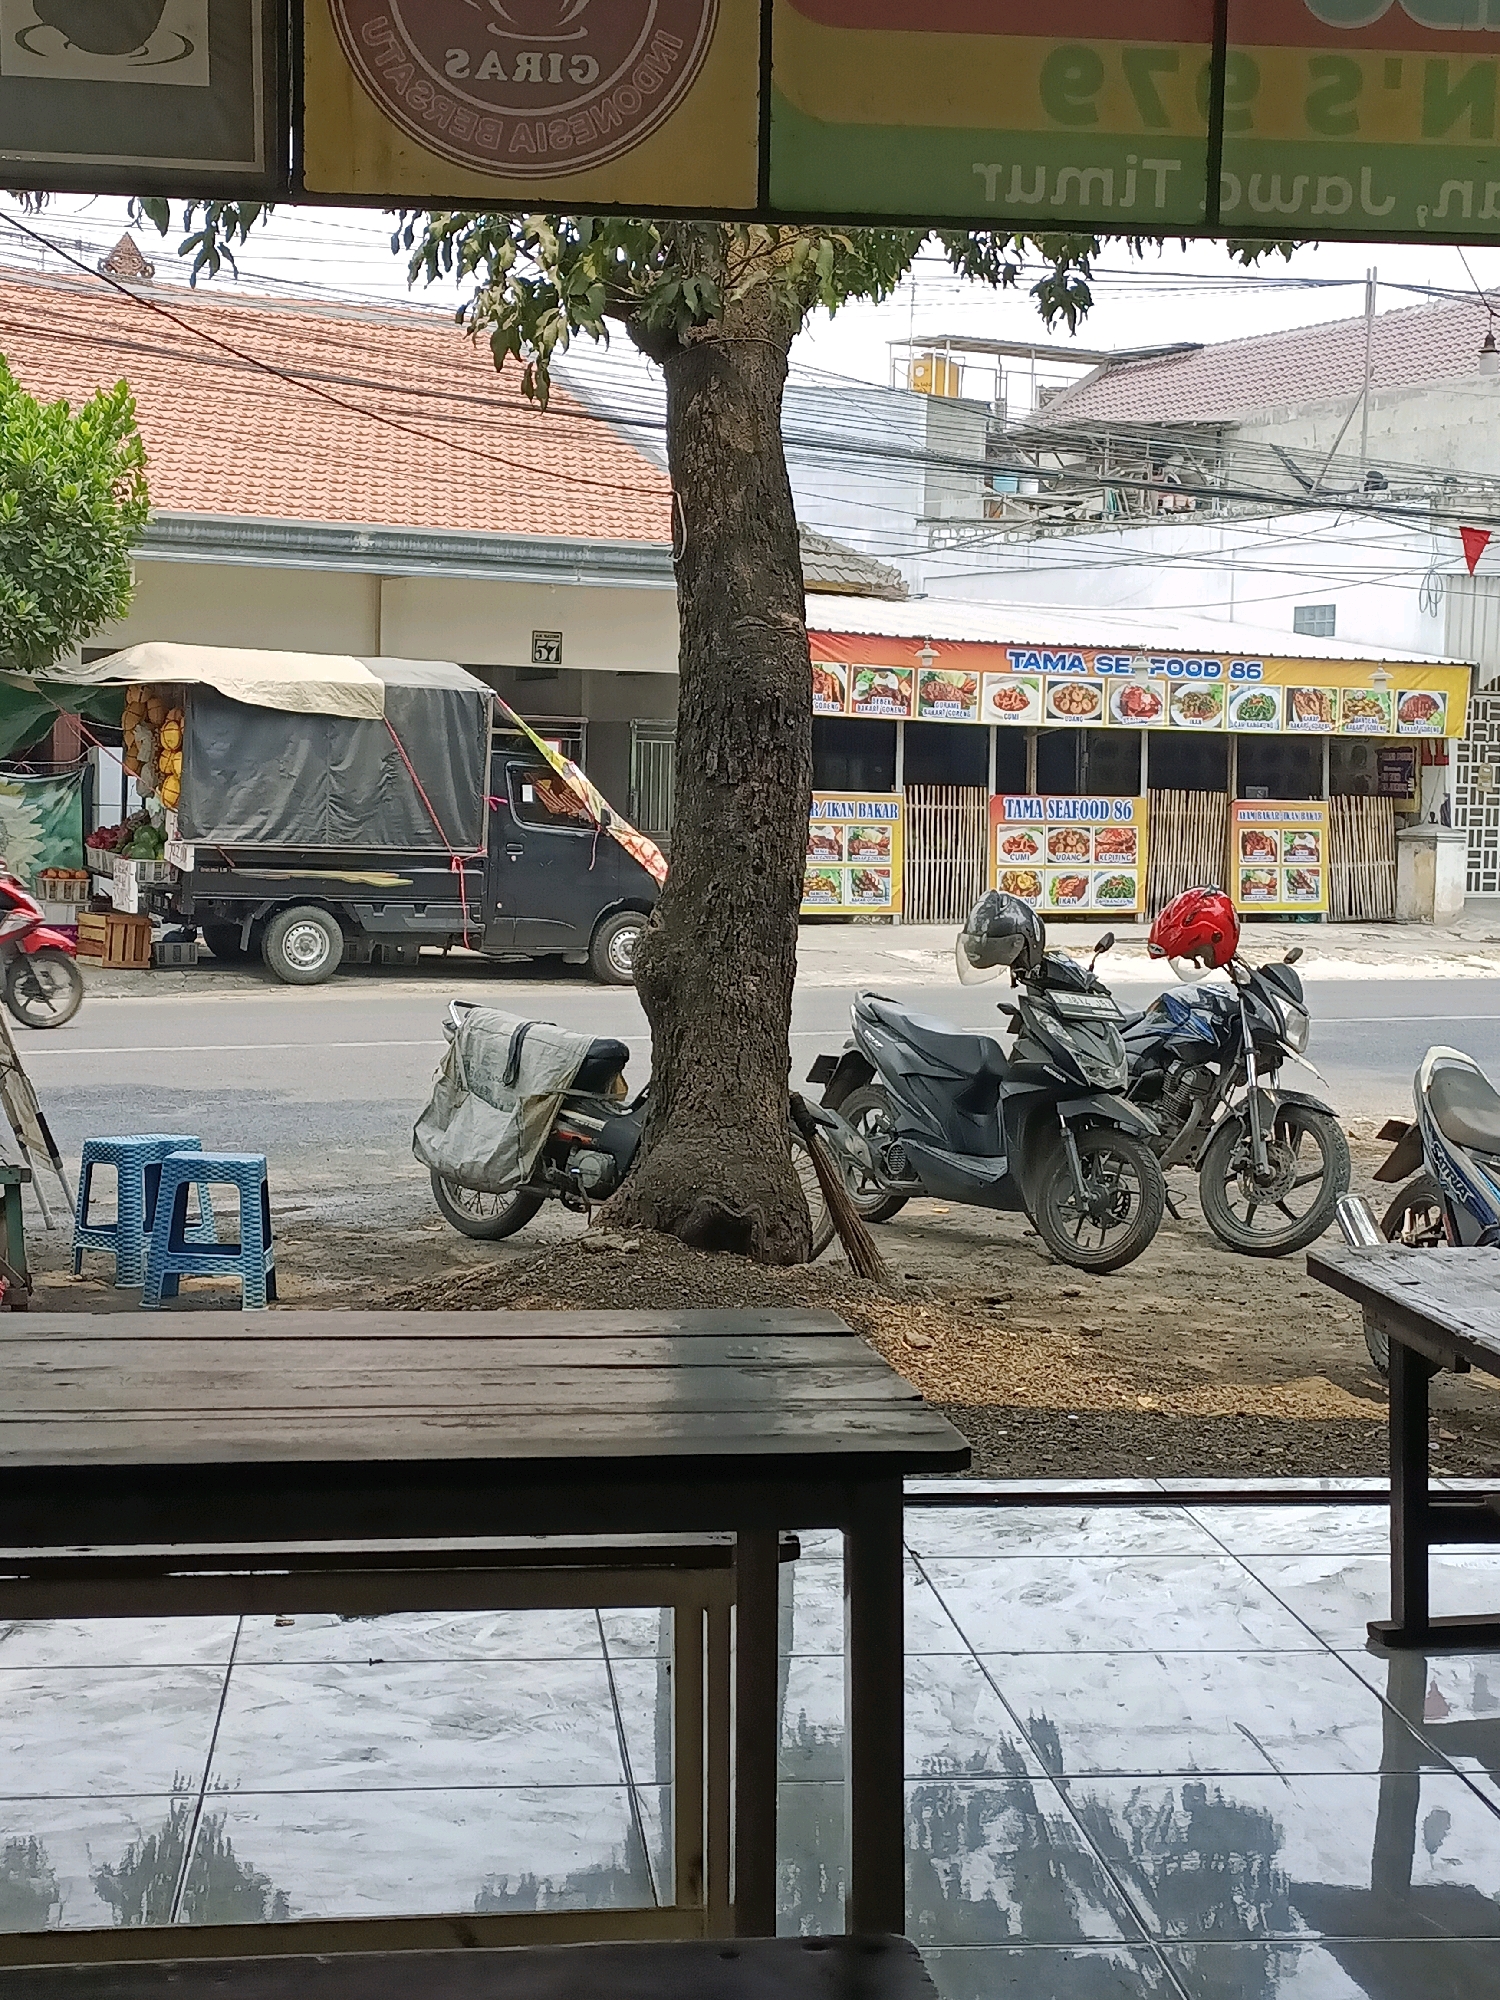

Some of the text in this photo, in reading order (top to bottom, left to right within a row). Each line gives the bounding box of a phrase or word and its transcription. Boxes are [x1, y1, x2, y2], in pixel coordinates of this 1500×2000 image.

[534, 640, 560, 661] 57
[1008, 651, 1262, 680] TAMA SEFOOD 86
[858, 802, 898, 818] BAKAR
[1005, 799, 1132, 819] TAMA SEAFOOD 86
[1010, 853, 1030, 861] CUMI
[1059, 897, 1077, 905] IKAN
[1430, 1140, 1475, 1203] SATRIA
